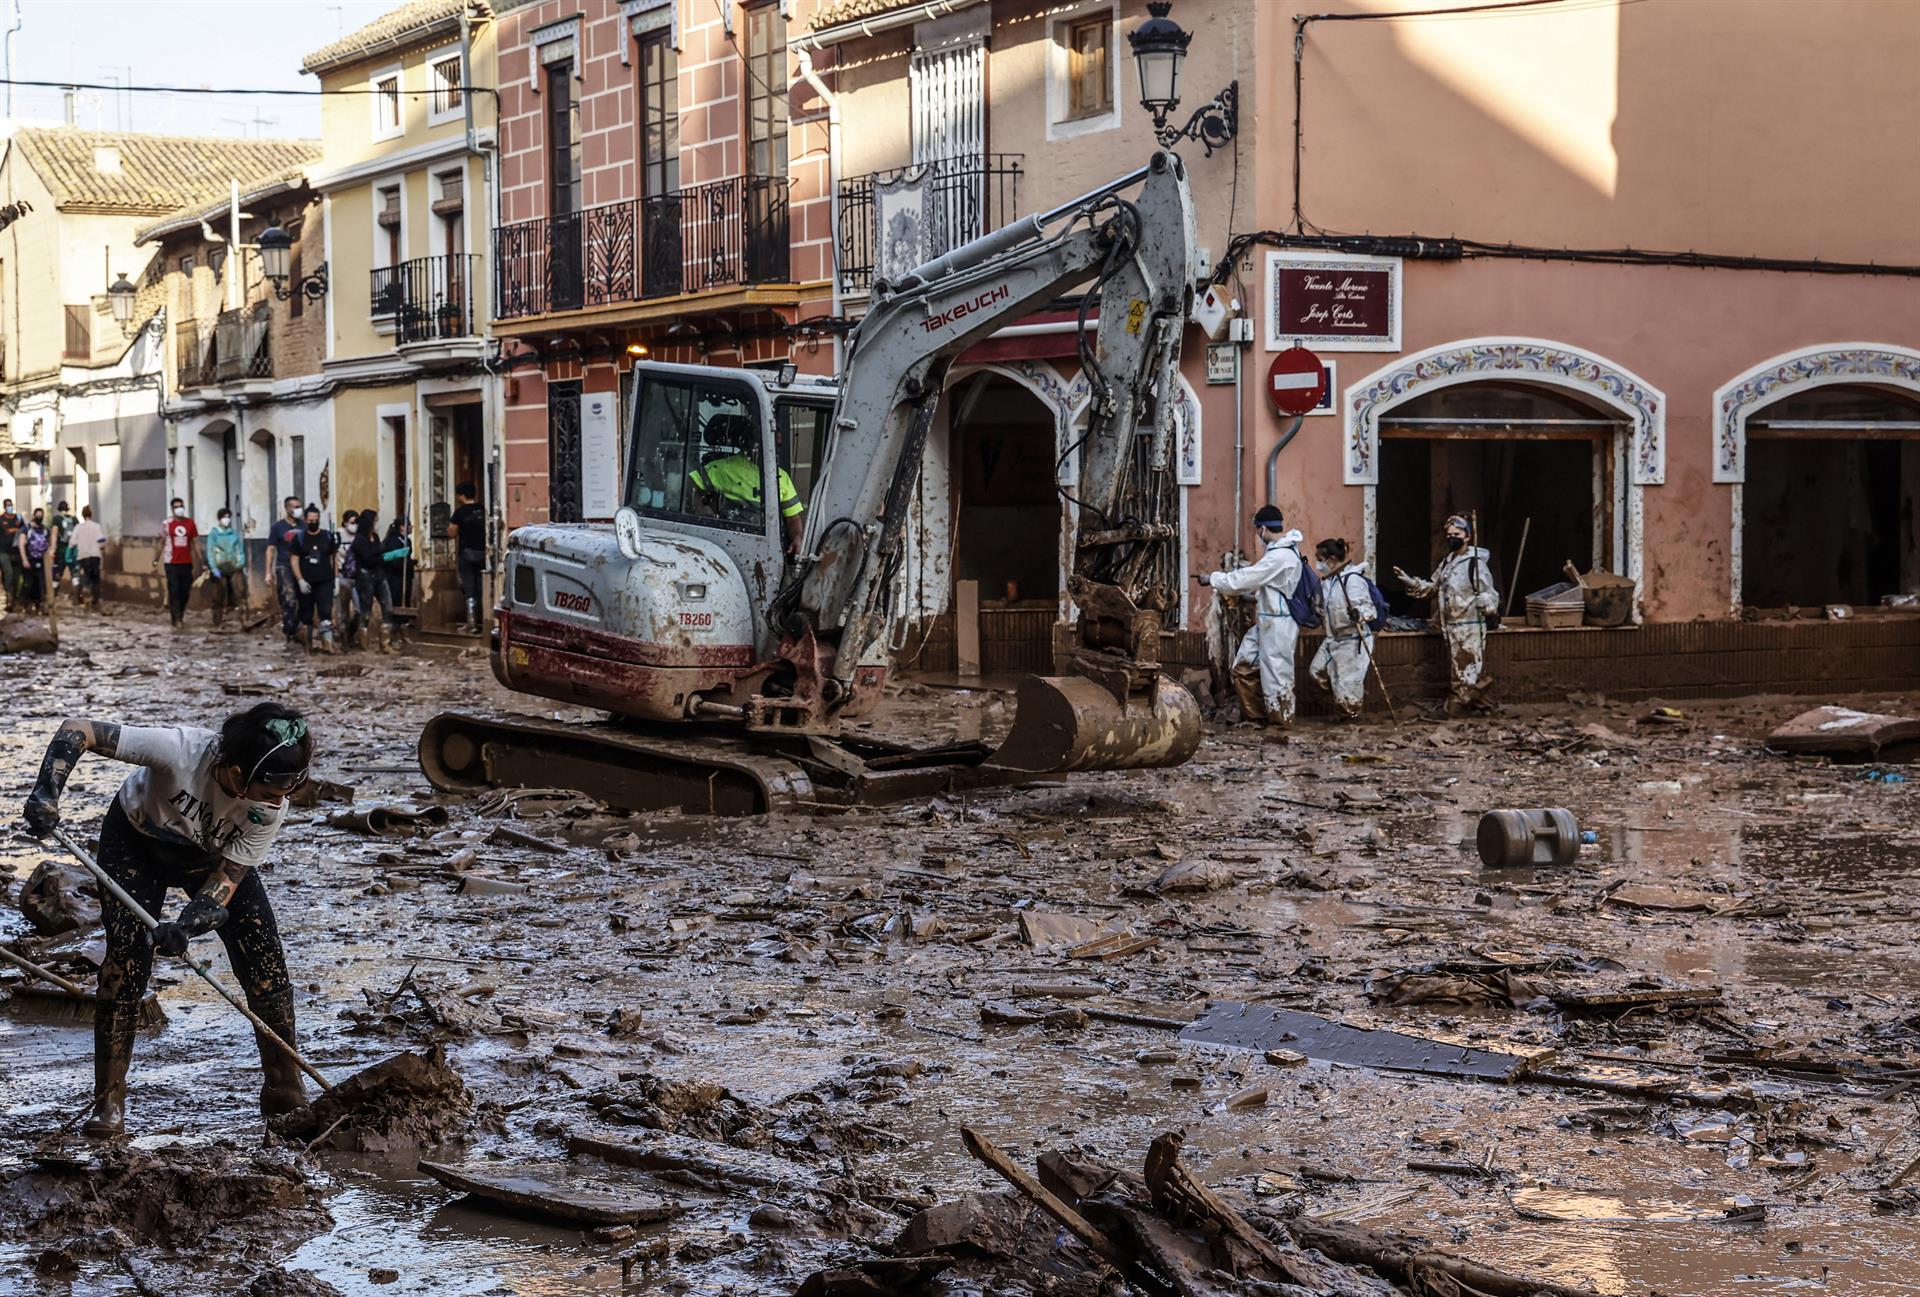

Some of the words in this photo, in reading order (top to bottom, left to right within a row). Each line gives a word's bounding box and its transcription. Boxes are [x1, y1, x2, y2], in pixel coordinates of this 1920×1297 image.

[1303, 275, 1333, 290] Vicente
[1335, 277, 1368, 292] Moreno
[1300, 304, 1328, 323] Josep
[1331, 304, 1354, 319] Corts
[554, 591, 591, 612] TB260
[679, 613, 711, 626] TB260
